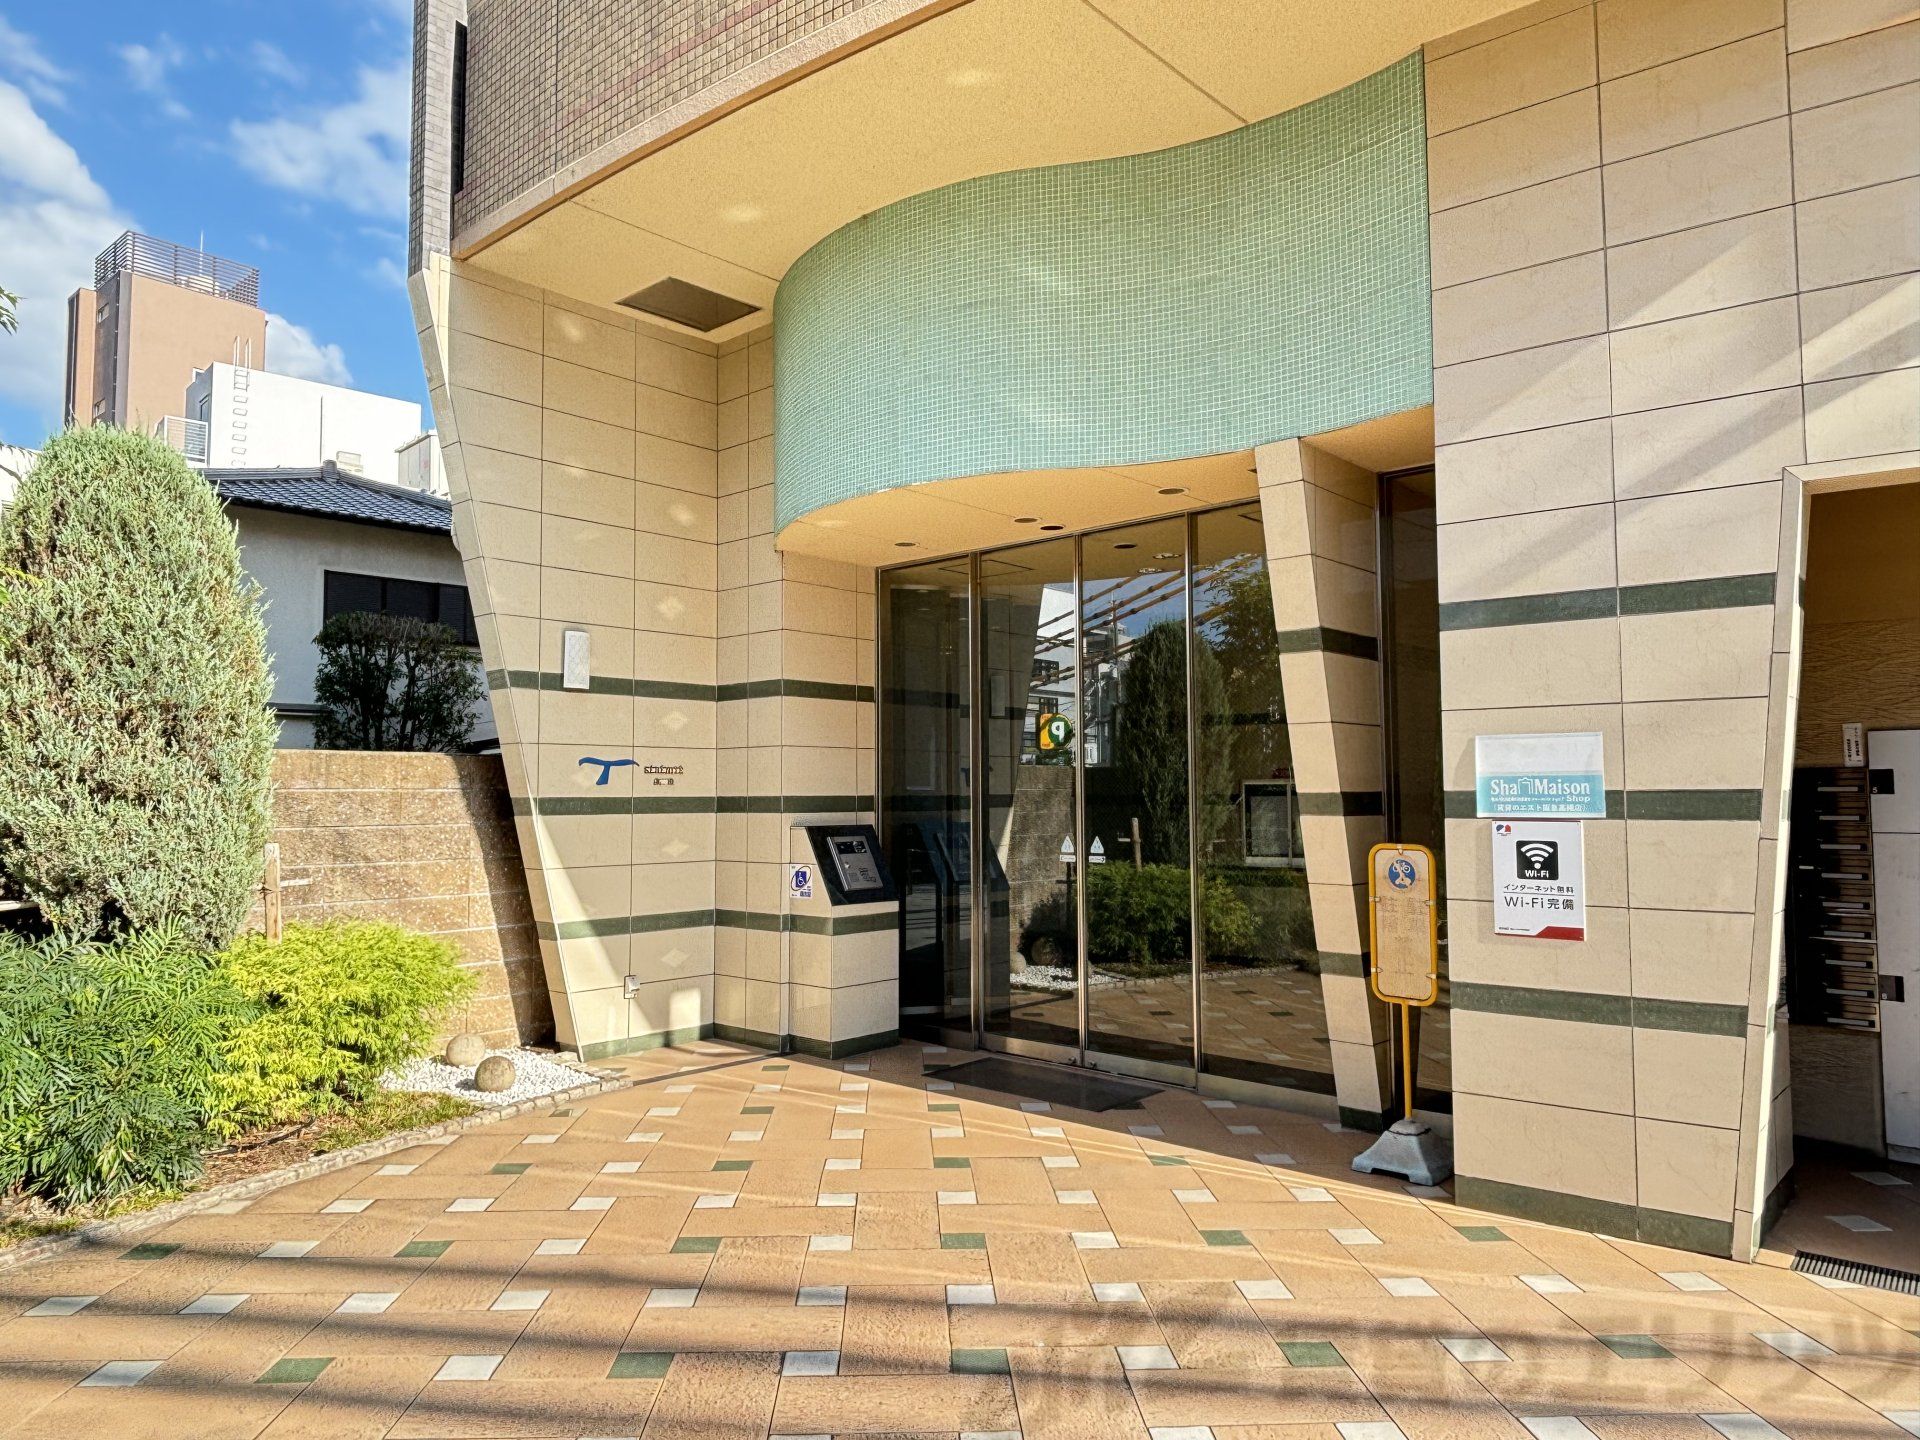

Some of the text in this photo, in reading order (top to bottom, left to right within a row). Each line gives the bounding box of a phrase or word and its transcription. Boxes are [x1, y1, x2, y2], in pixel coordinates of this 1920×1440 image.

[1490, 778, 1591, 795] Sha Maison
[1566, 795, 1591, 803] Shop
[1525, 869, 1550, 878] Wi-Fi
